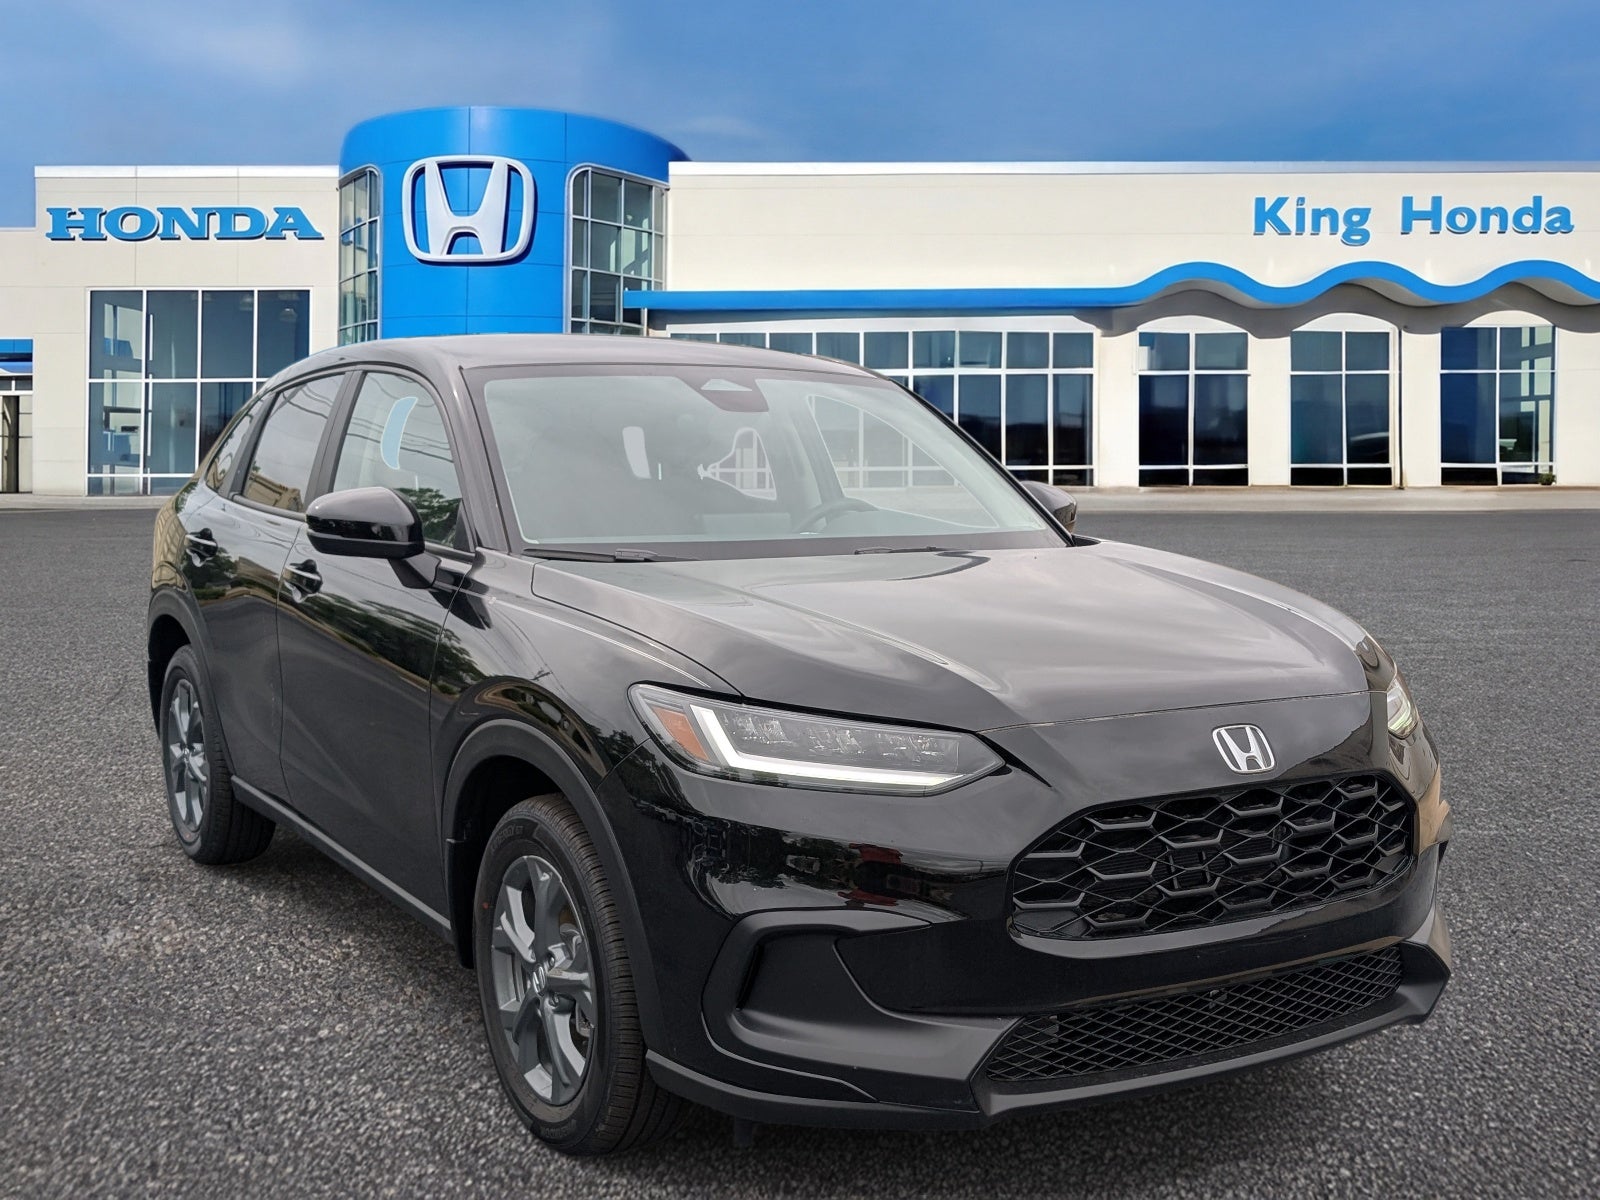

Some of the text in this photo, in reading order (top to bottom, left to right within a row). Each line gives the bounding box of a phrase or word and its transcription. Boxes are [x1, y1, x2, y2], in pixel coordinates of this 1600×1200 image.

[46, 206, 324, 240] HONDA
[1253, 195, 1575, 246] King Honda
